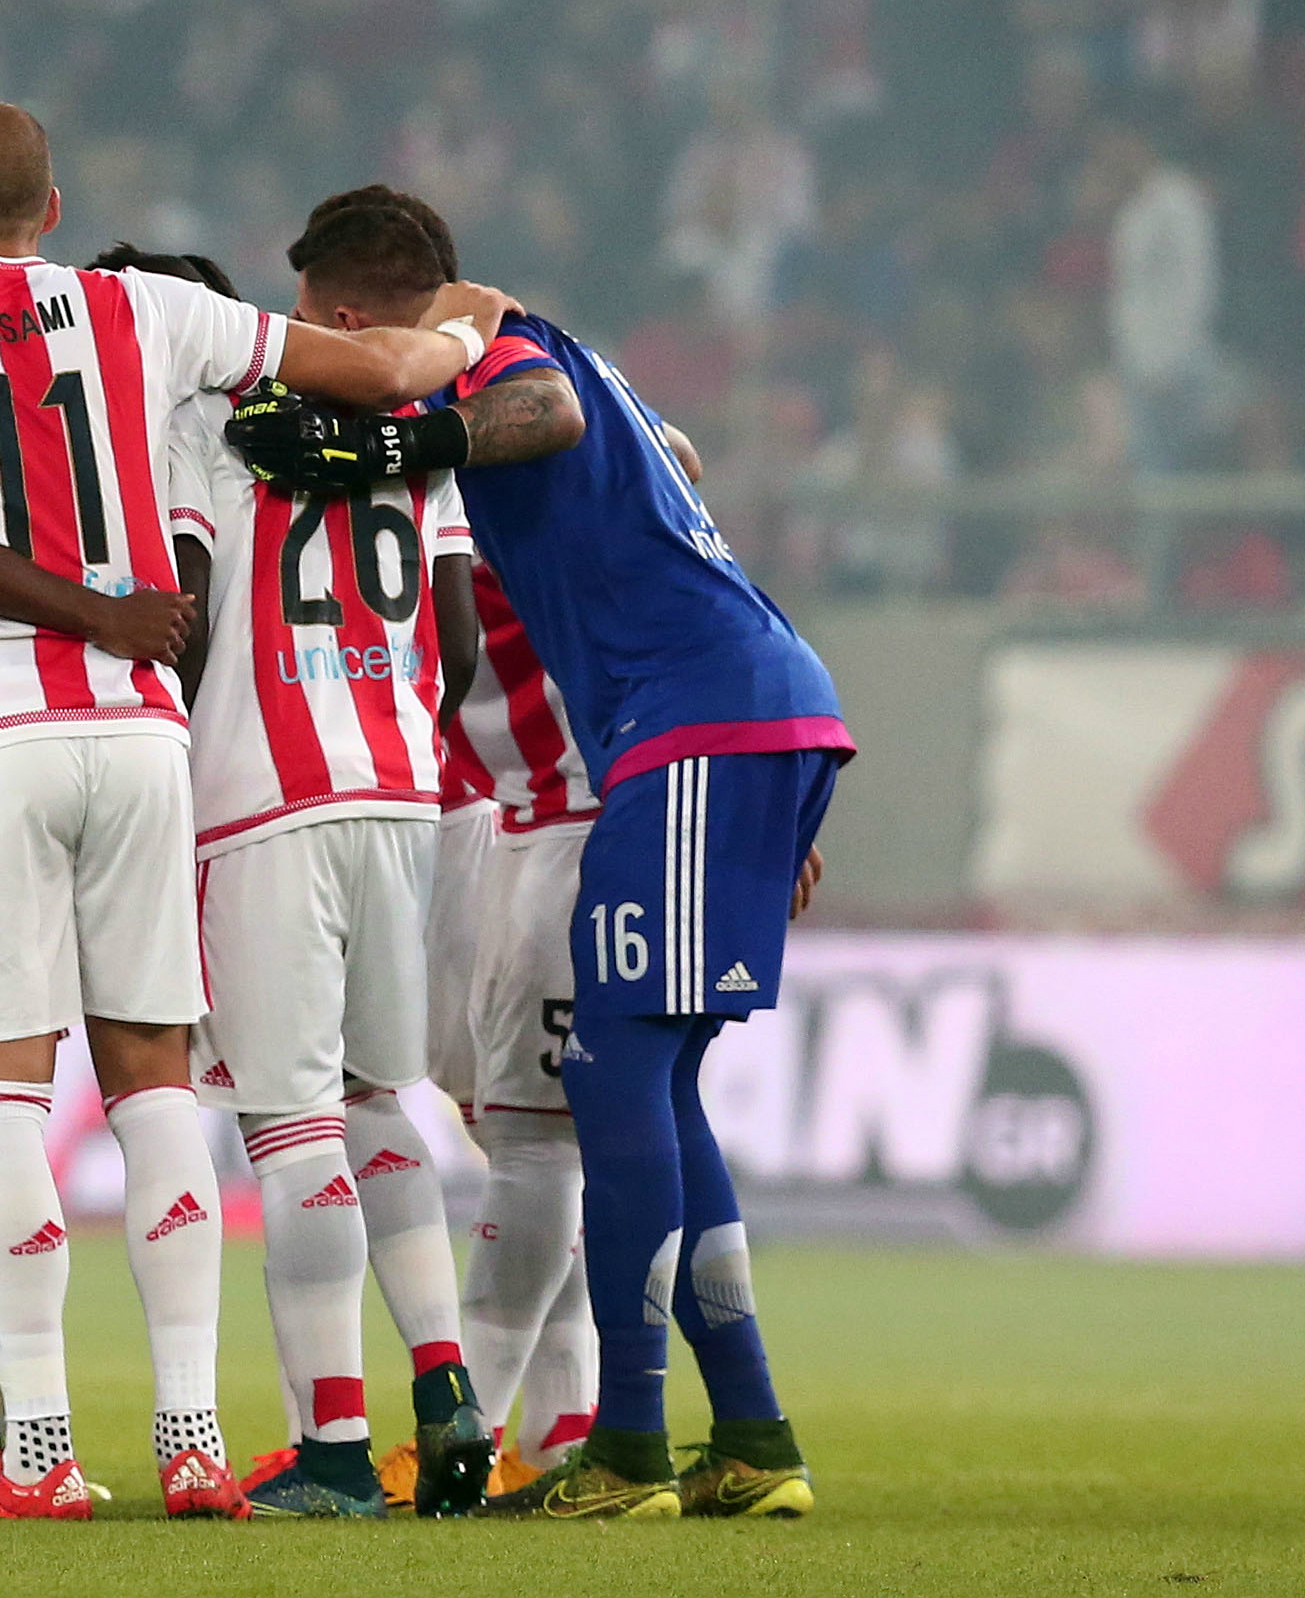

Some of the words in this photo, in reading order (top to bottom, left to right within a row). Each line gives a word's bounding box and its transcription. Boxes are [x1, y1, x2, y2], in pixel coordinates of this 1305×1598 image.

[380, 424, 402, 475] RJ16
[279, 492, 421, 627] 26
[590, 902, 649, 984] 16
[146, 1209, 207, 1241] adidas
